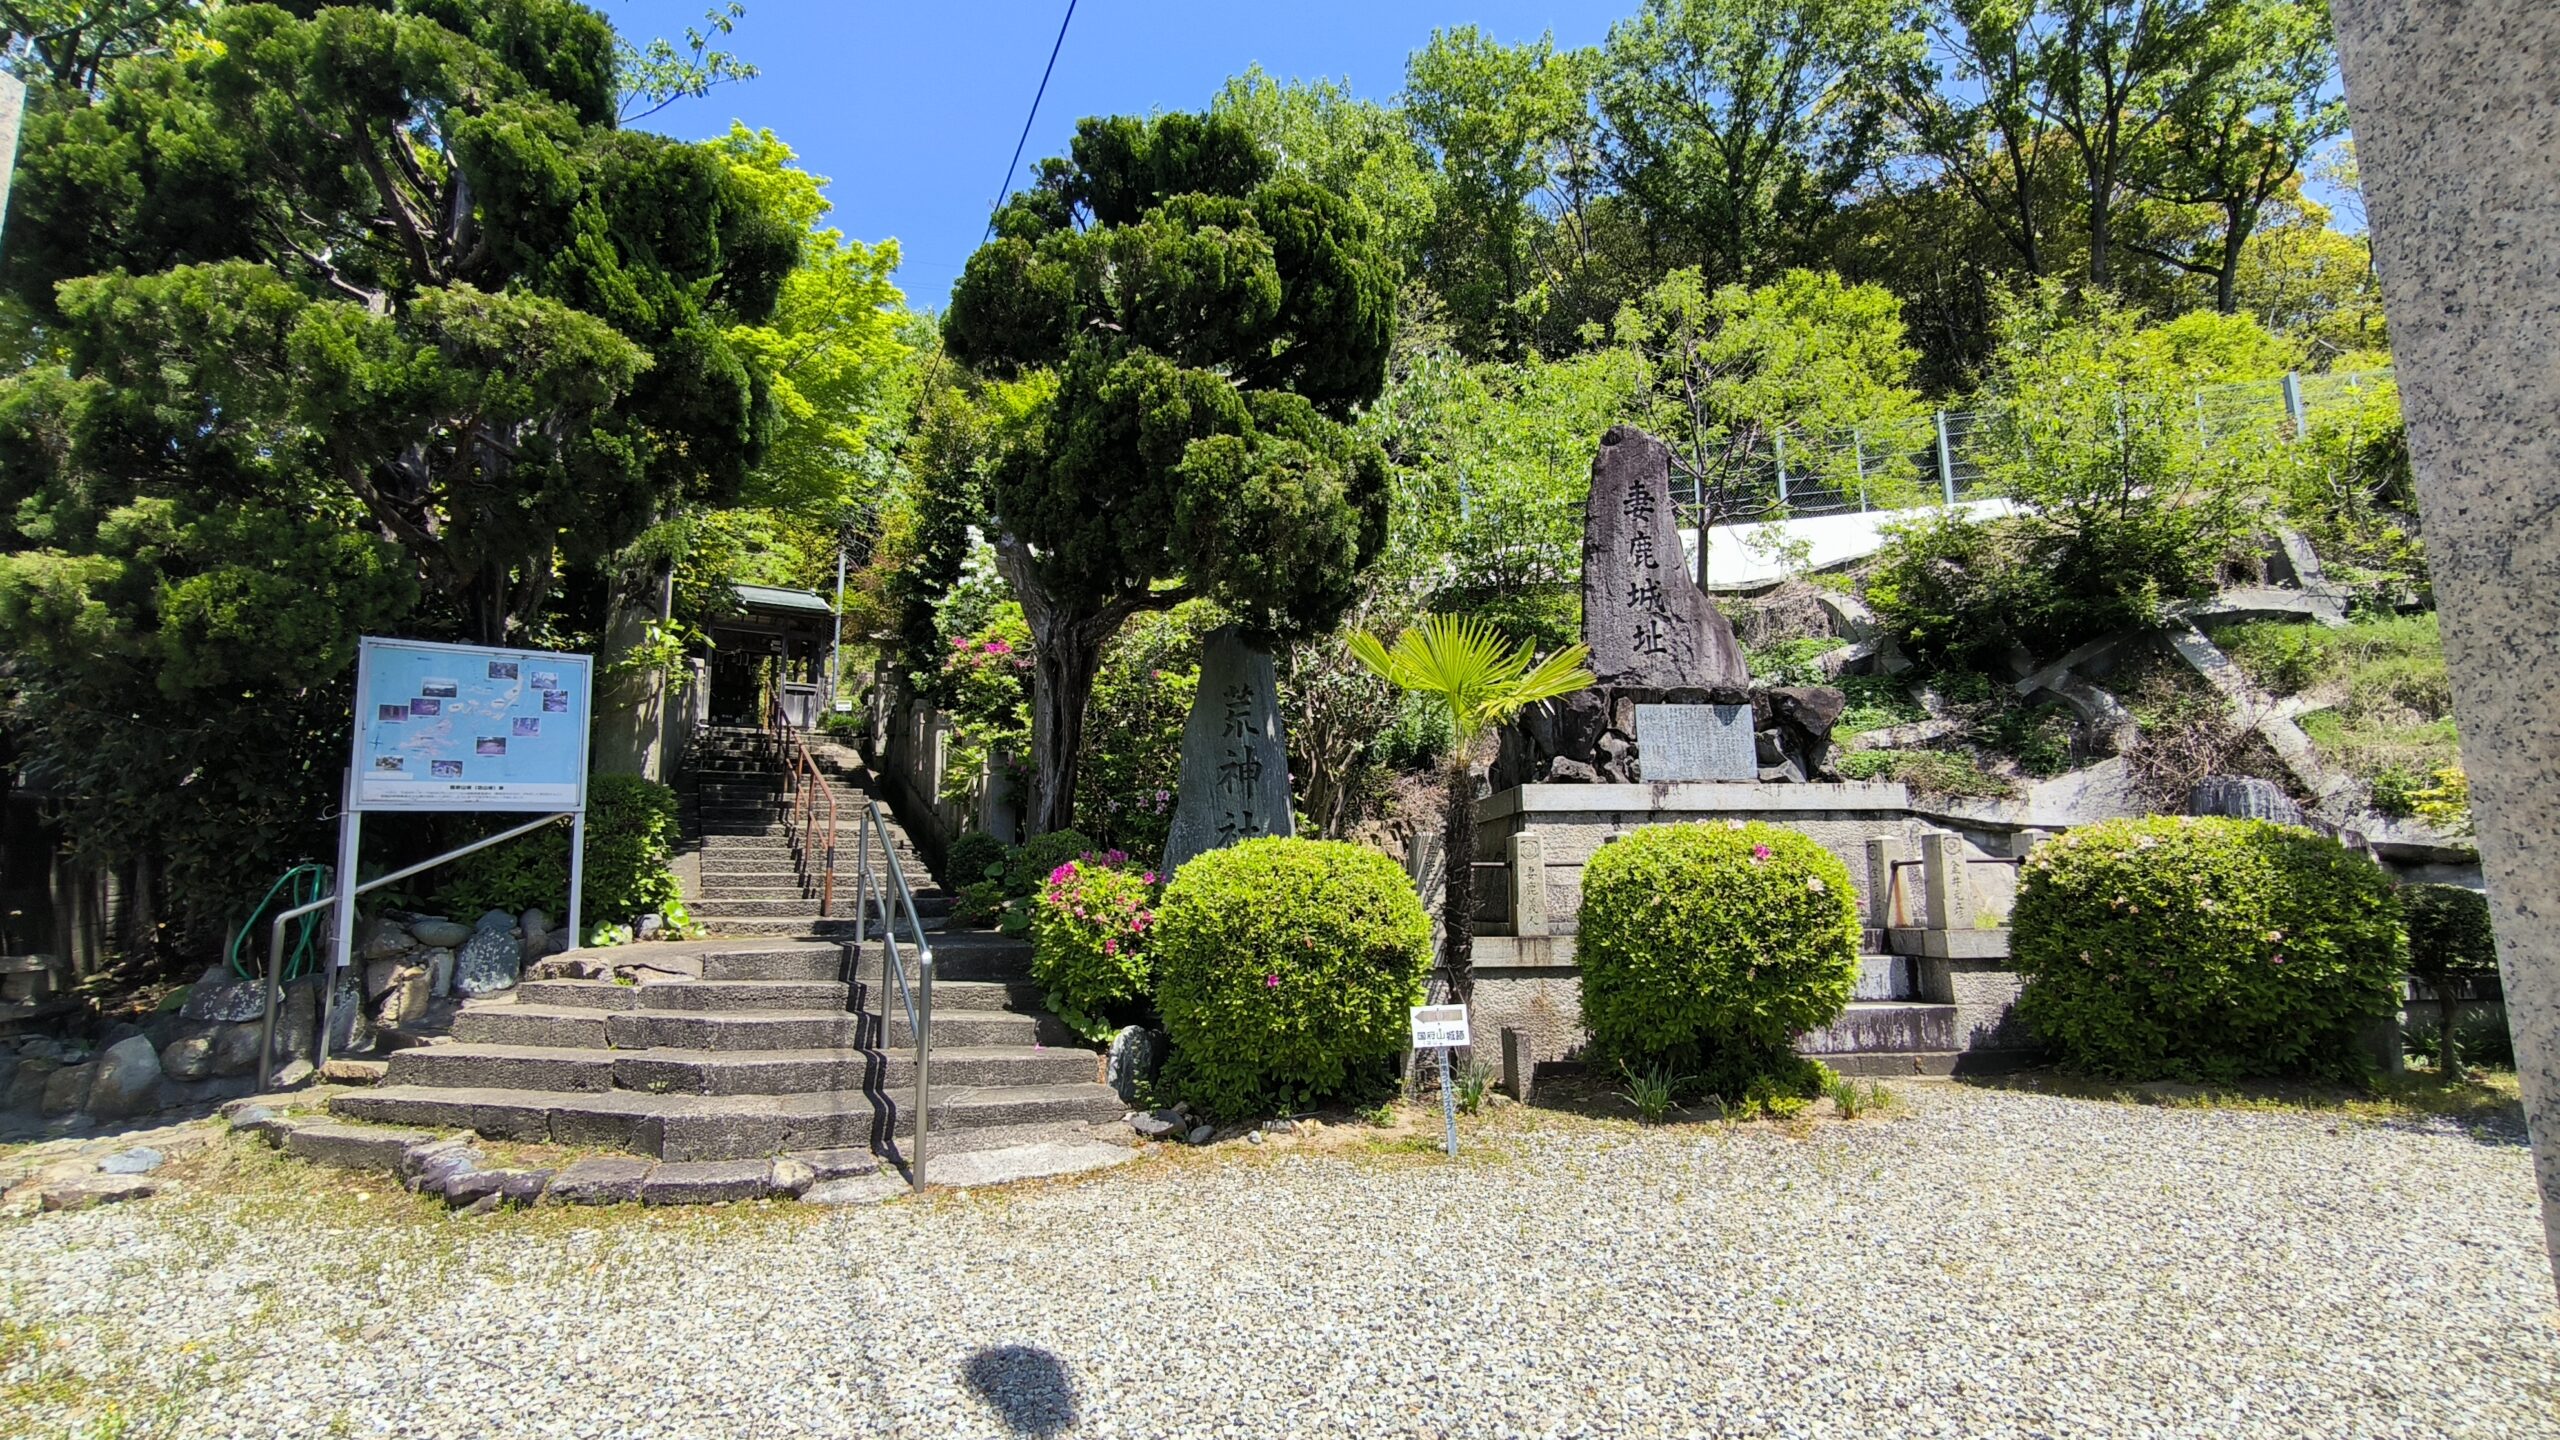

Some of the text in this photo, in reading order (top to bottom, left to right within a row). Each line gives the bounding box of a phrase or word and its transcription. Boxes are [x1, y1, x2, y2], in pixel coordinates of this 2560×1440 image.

[1622, 479, 1667, 656] 妻鹿城址
[1217, 683, 1263, 849] 荒神社
[1417, 1028, 1465, 1041] 国府山城跡
